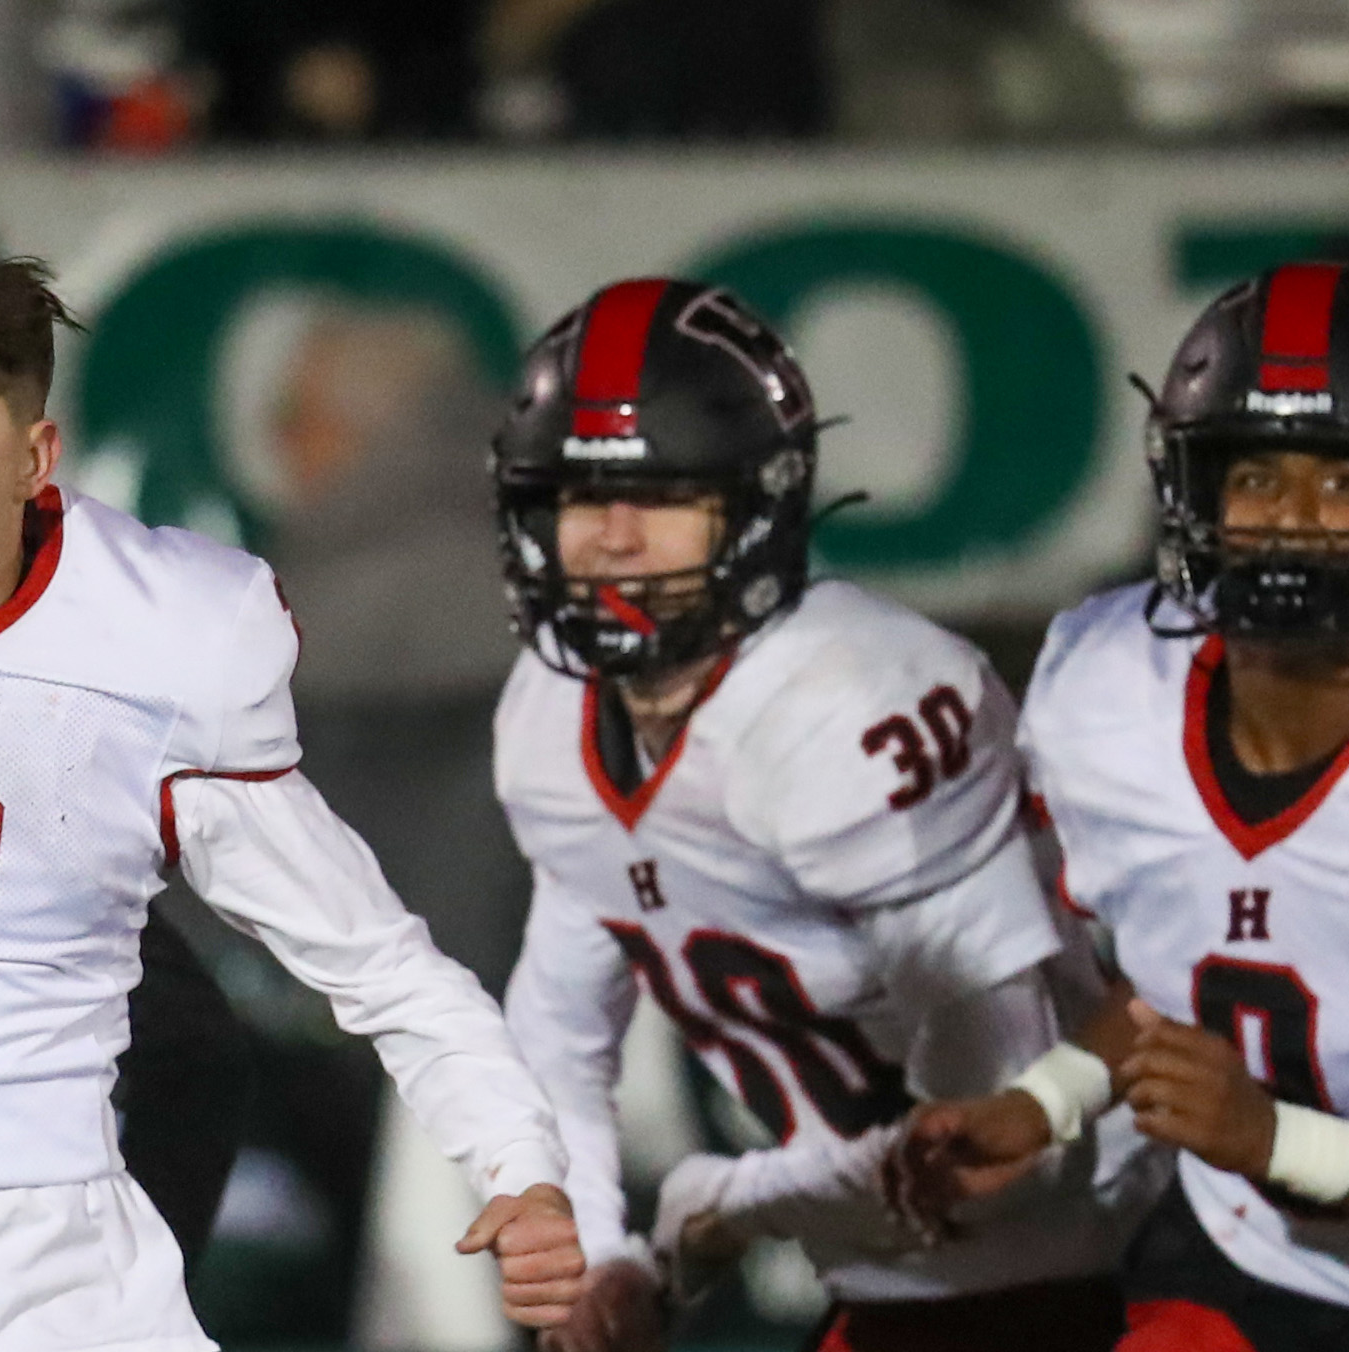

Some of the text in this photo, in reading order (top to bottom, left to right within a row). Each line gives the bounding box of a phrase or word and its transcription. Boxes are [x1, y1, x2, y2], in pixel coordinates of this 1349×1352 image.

[860, 684, 974, 812] 30
[627, 857, 666, 912] H
[1225, 888, 1270, 942] H
